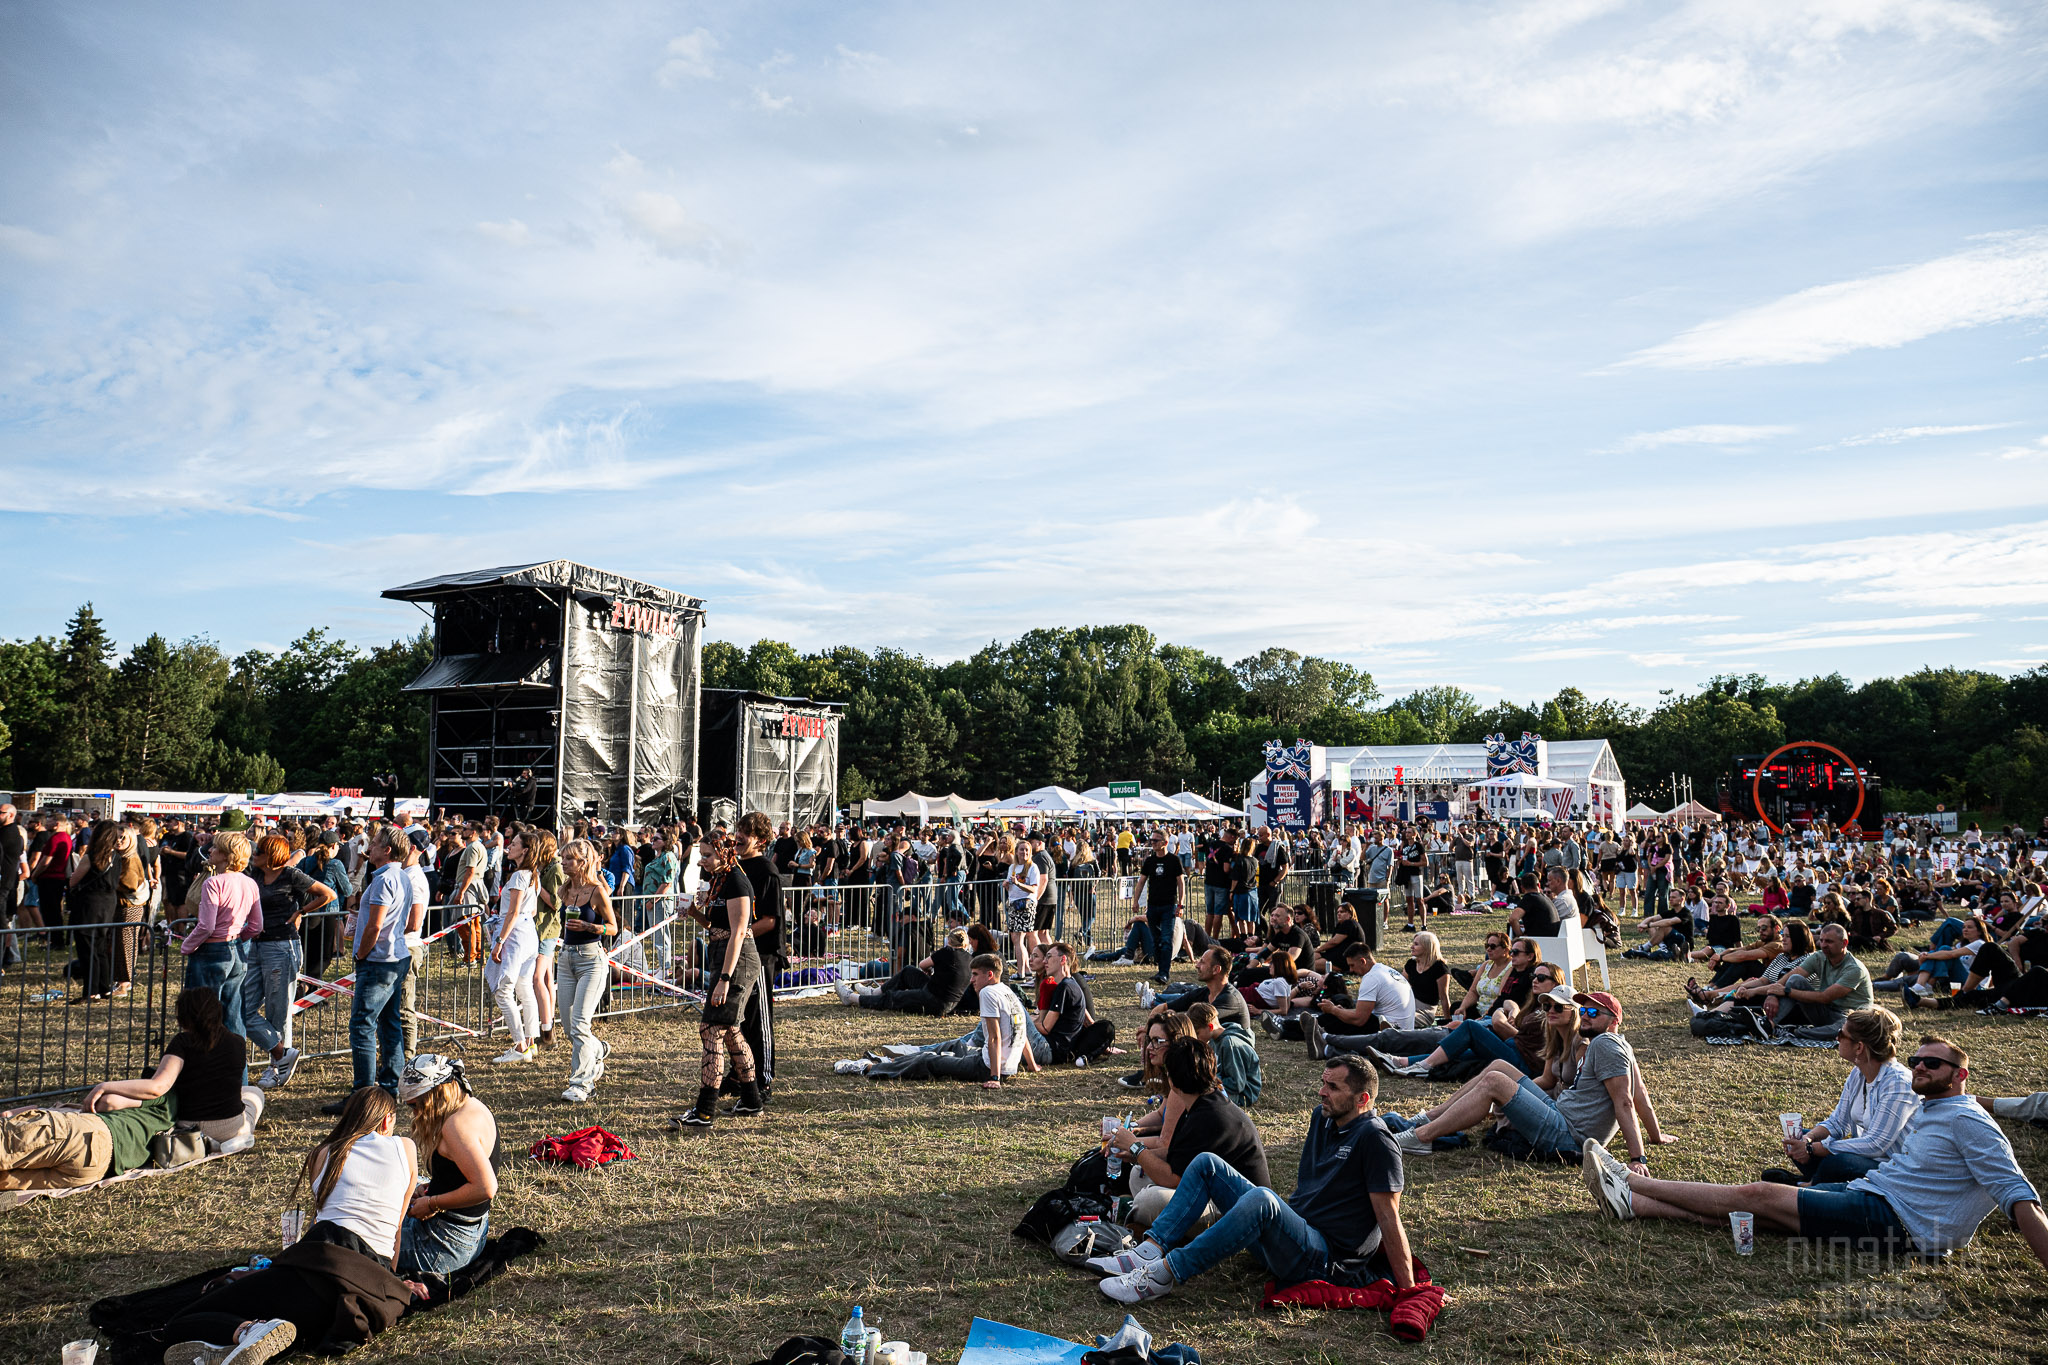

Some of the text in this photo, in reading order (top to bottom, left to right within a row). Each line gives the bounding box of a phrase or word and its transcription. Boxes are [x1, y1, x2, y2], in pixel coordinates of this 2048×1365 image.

[611, 601, 678, 638] ŻYWIEC
[782, 711, 826, 739] ŻYWIEC
[330, 787, 364, 799] ŻYWIEC
[1112, 785, 1137, 795] WYJŚCIE
[1491, 798, 1516, 808] LAT
